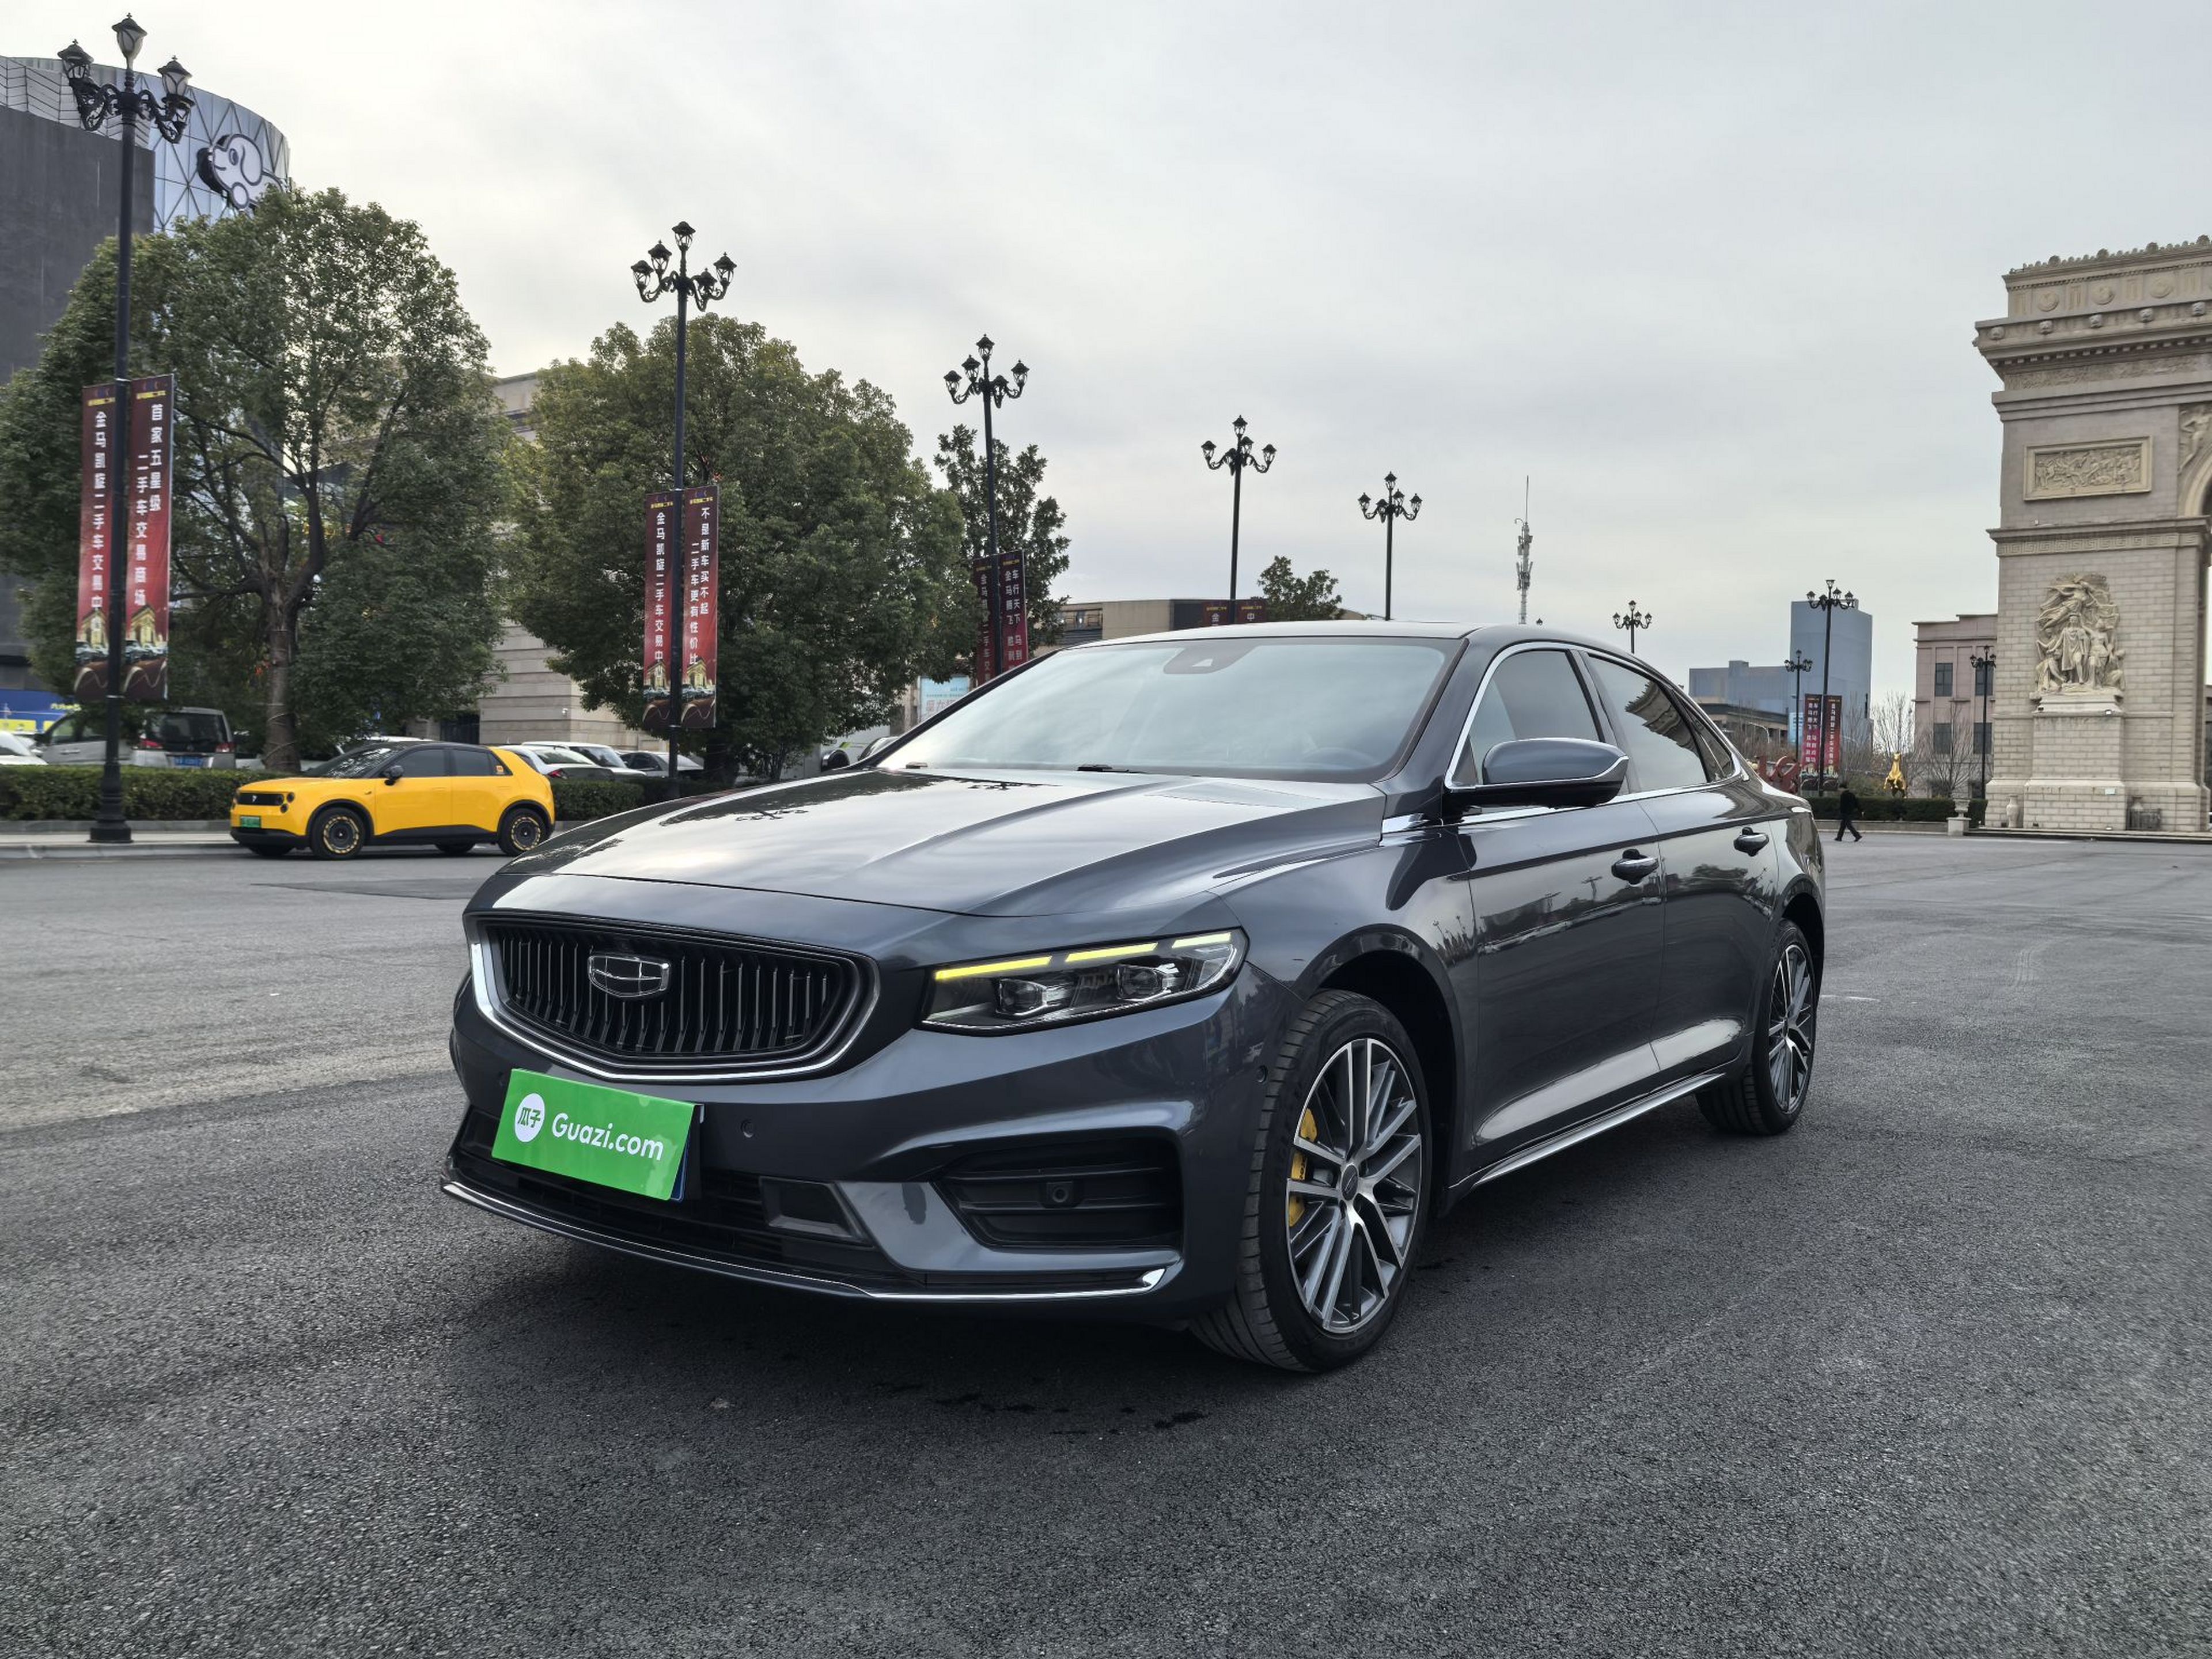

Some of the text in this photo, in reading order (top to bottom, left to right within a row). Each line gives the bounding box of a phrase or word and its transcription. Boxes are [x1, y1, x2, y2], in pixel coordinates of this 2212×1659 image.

[700, 507, 710, 615] 不是新车买不起
[690, 543, 700, 664] 二手车更有性价比
[518, 1107, 541, 1128] 瓜子
[551, 1112, 664, 1161] Guazi.com
